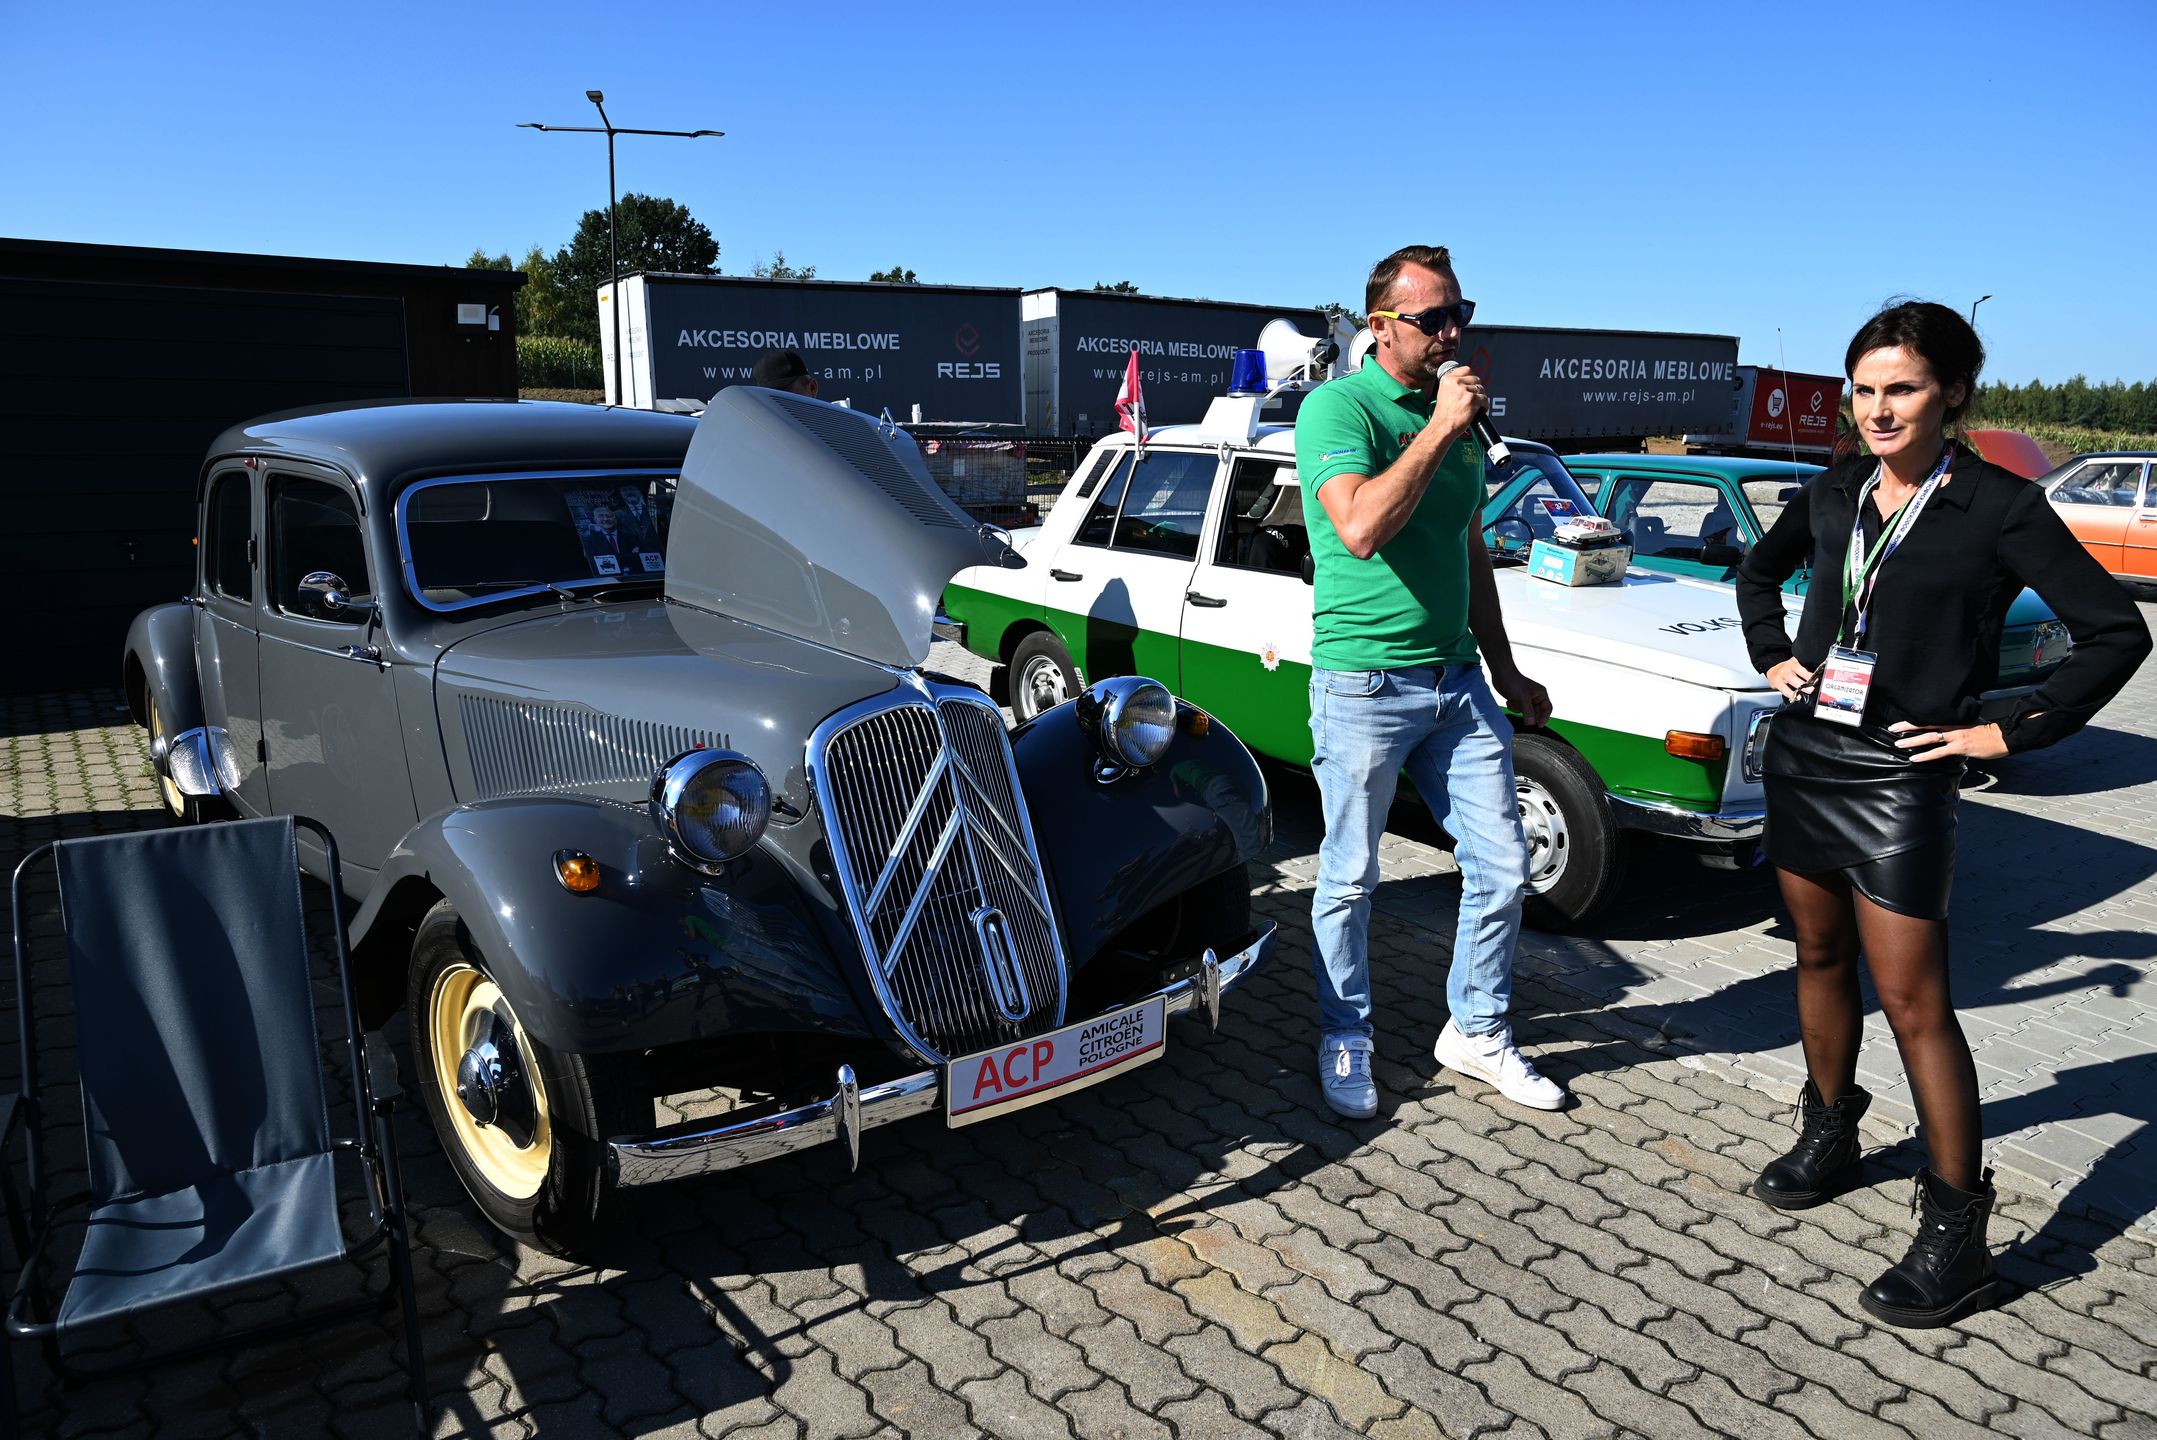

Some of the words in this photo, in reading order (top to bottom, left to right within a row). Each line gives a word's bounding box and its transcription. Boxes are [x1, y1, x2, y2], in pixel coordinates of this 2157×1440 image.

[677, 330, 800, 349] AKCESORIA
[804, 332, 900, 350] MEBLOWE
[1076, 336, 1165, 356] AKCESORIA
[1168, 341, 1239, 360] MEBLOWE
[703, 364, 882, 382] www-am.pl
[937, 362, 1001, 379] REJS
[1094, 368, 1224, 386] wwwrejs-am.pl
[1539, 358, 1647, 379] AKCESORIA
[1653, 360, 1734, 381] MEBLOWE
[1582, 389, 1695, 405] www.rejs-am.pl
[1799, 414, 1828, 427] REJS
[1079, 1009, 1144, 1043] AMICALE
[1079, 1024, 1144, 1056] CITROËN
[1079, 1036, 1143, 1067] POLOGNE
[972, 1039, 1054, 1100] ACP
